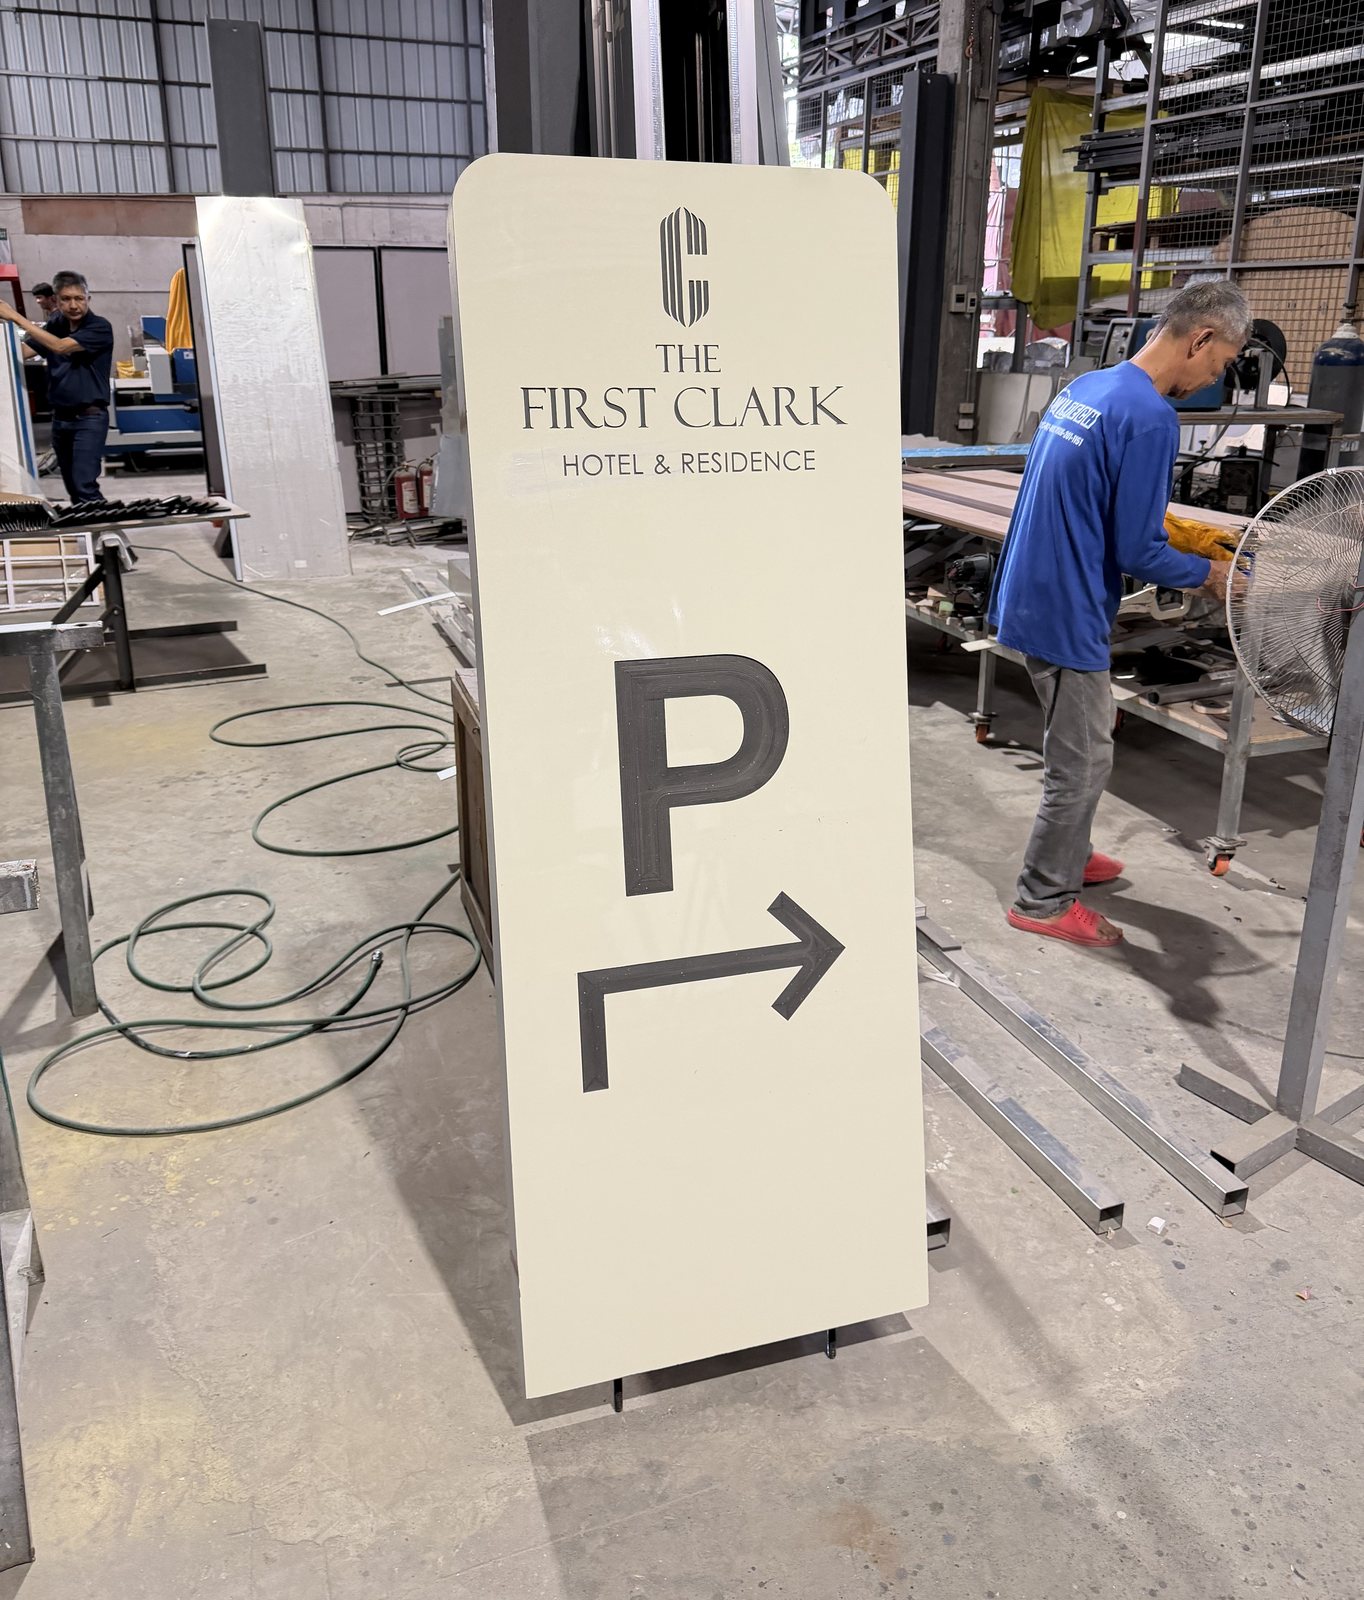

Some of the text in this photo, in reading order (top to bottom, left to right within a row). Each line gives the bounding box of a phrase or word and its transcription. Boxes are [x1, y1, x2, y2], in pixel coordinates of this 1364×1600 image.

[656, 344, 721, 372] THE
[521, 386, 847, 429] FIRST CLARK
[563, 450, 815, 476] HOTEL & RESIDENCE
[614, 654, 790, 897] P
